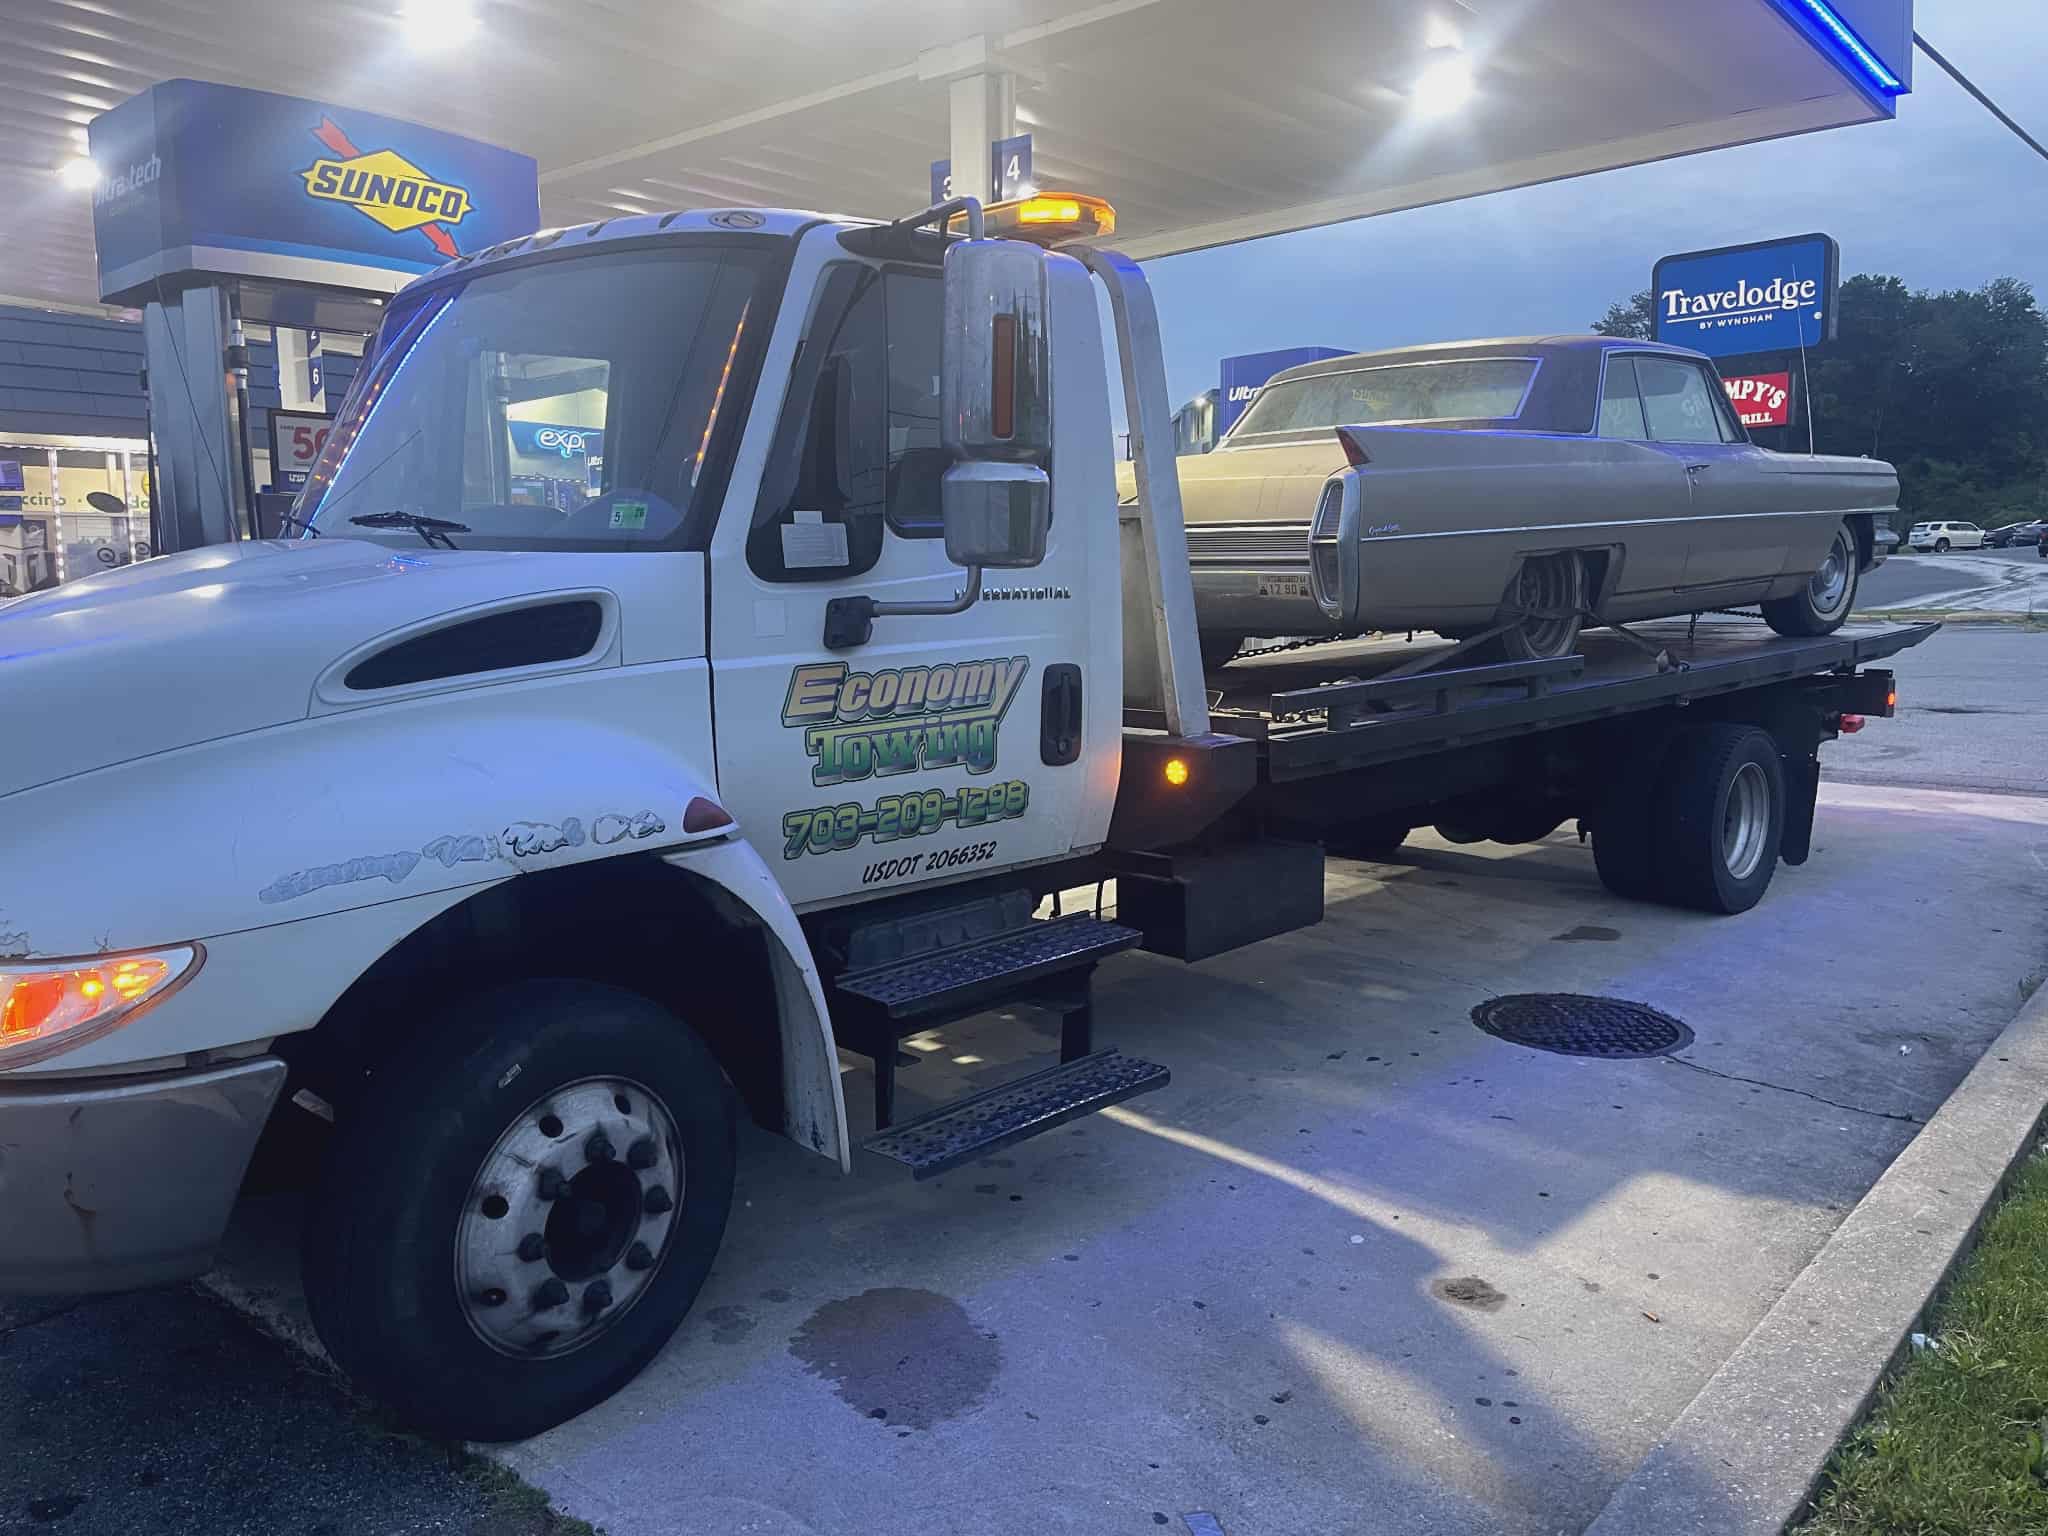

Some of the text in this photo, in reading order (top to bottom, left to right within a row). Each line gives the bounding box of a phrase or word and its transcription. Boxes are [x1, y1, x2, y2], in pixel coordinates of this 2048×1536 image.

[1006, 154, 1020, 181] 4
[312, 164, 464, 219] SUNOCO
[1661, 277, 1817, 317] Travelodge
[1699, 313, 1773, 330] BY WYNDHAM
[312, 368, 320, 385] 6
[954, 586, 1072, 602] IERNATIONAL
[781, 656, 1030, 728] Economy
[805, 717, 1000, 787] Towing
[783, 779, 1030, 861] 703-209-1298
[862, 841, 998, 884] USDOT 2066352
